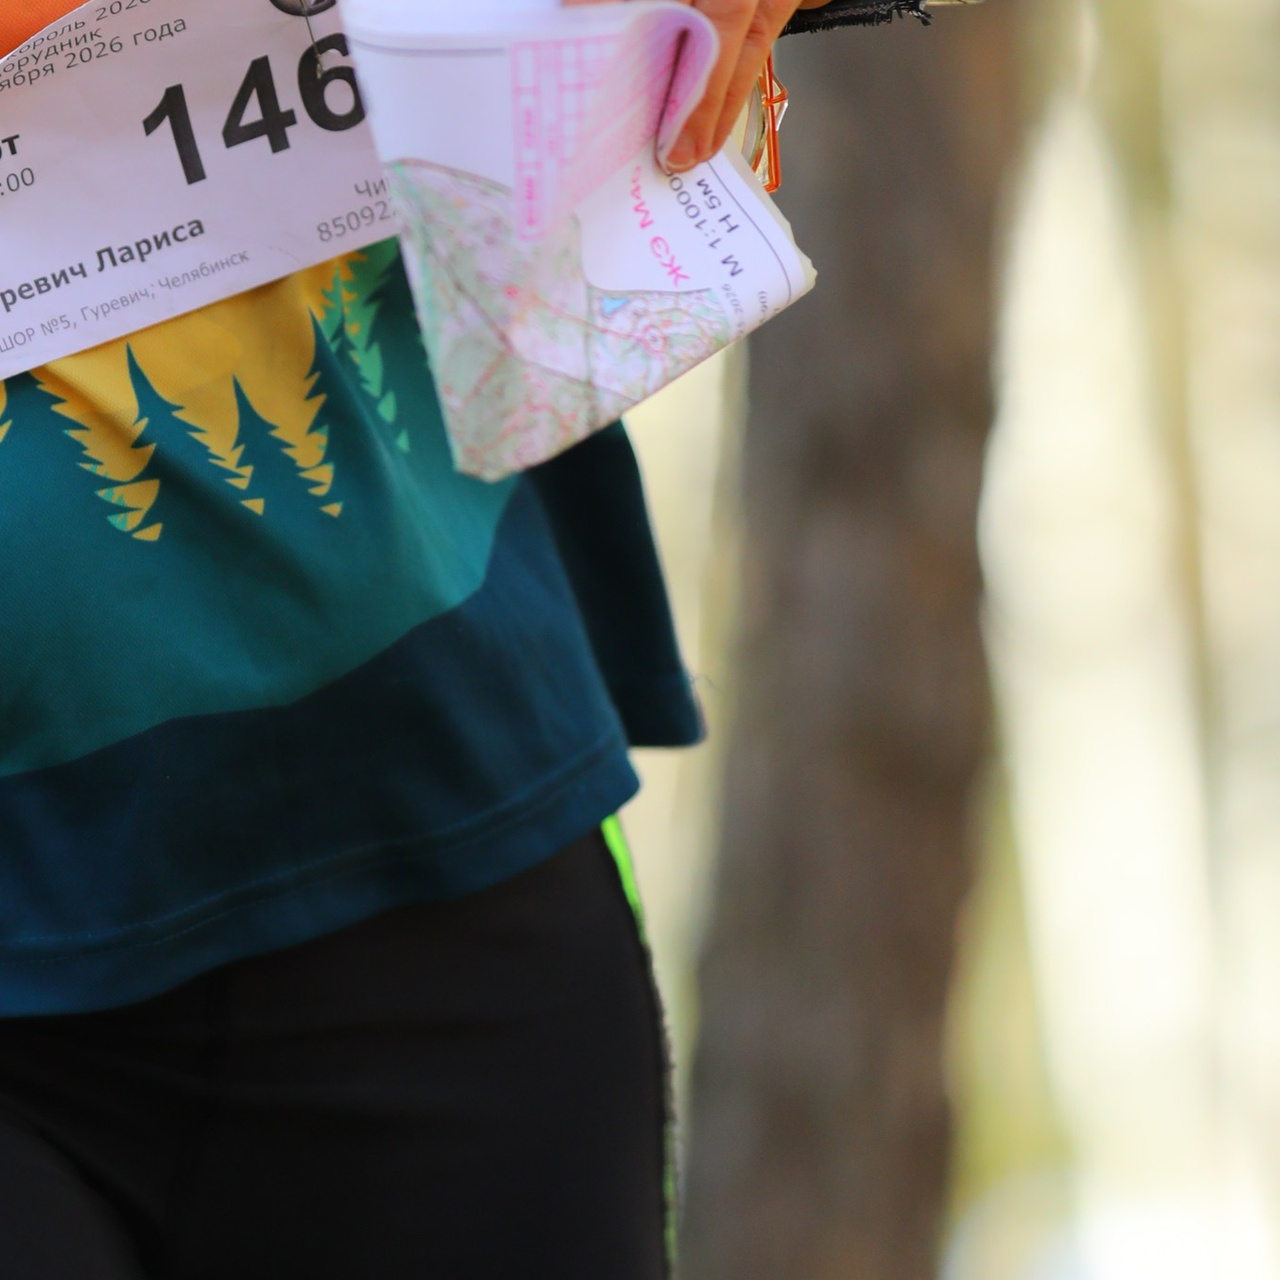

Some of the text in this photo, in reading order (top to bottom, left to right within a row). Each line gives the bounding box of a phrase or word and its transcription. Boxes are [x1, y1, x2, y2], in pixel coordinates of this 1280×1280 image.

[65, 36, 123, 69] 2026
[133, 18, 187, 47] года
[142, 33, 365, 185] 146
[317, 199, 397, 242] 85092
[664, 172, 722, 249] 1:1000
[95, 219, 206, 272] Лариса
[80, 287, 157, 322] Гуревич,
[158, 250, 250, 291] Челябинск
